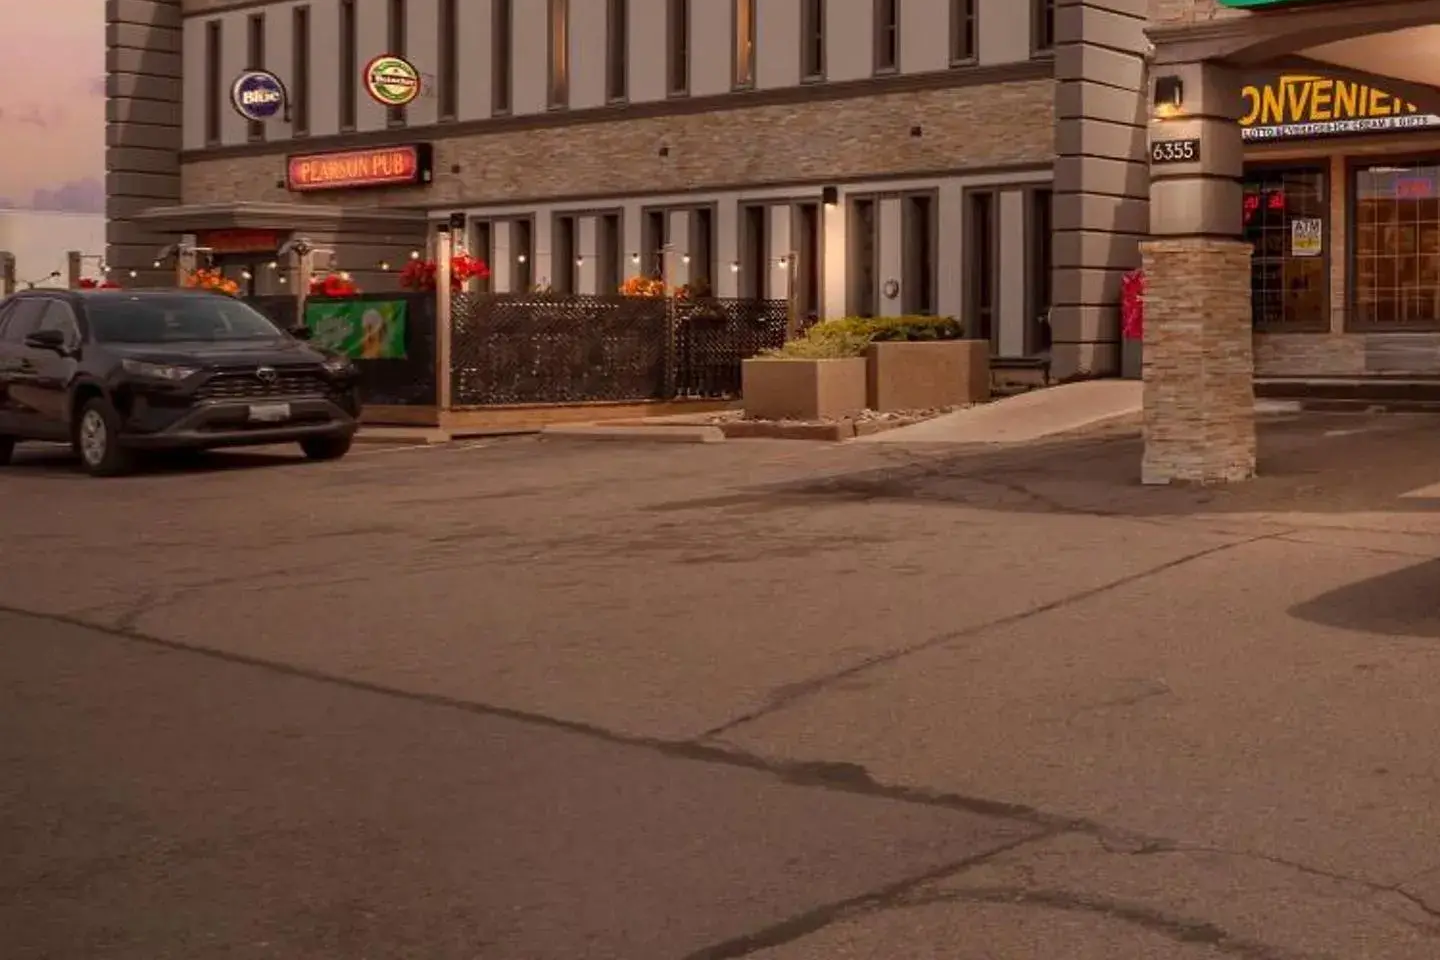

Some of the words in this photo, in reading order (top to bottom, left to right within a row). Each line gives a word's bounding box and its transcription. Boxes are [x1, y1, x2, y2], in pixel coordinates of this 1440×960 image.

[243, 90, 280, 105] Blue
[1153, 141, 1194, 160] 6355
[372, 152, 404, 176] PUB
